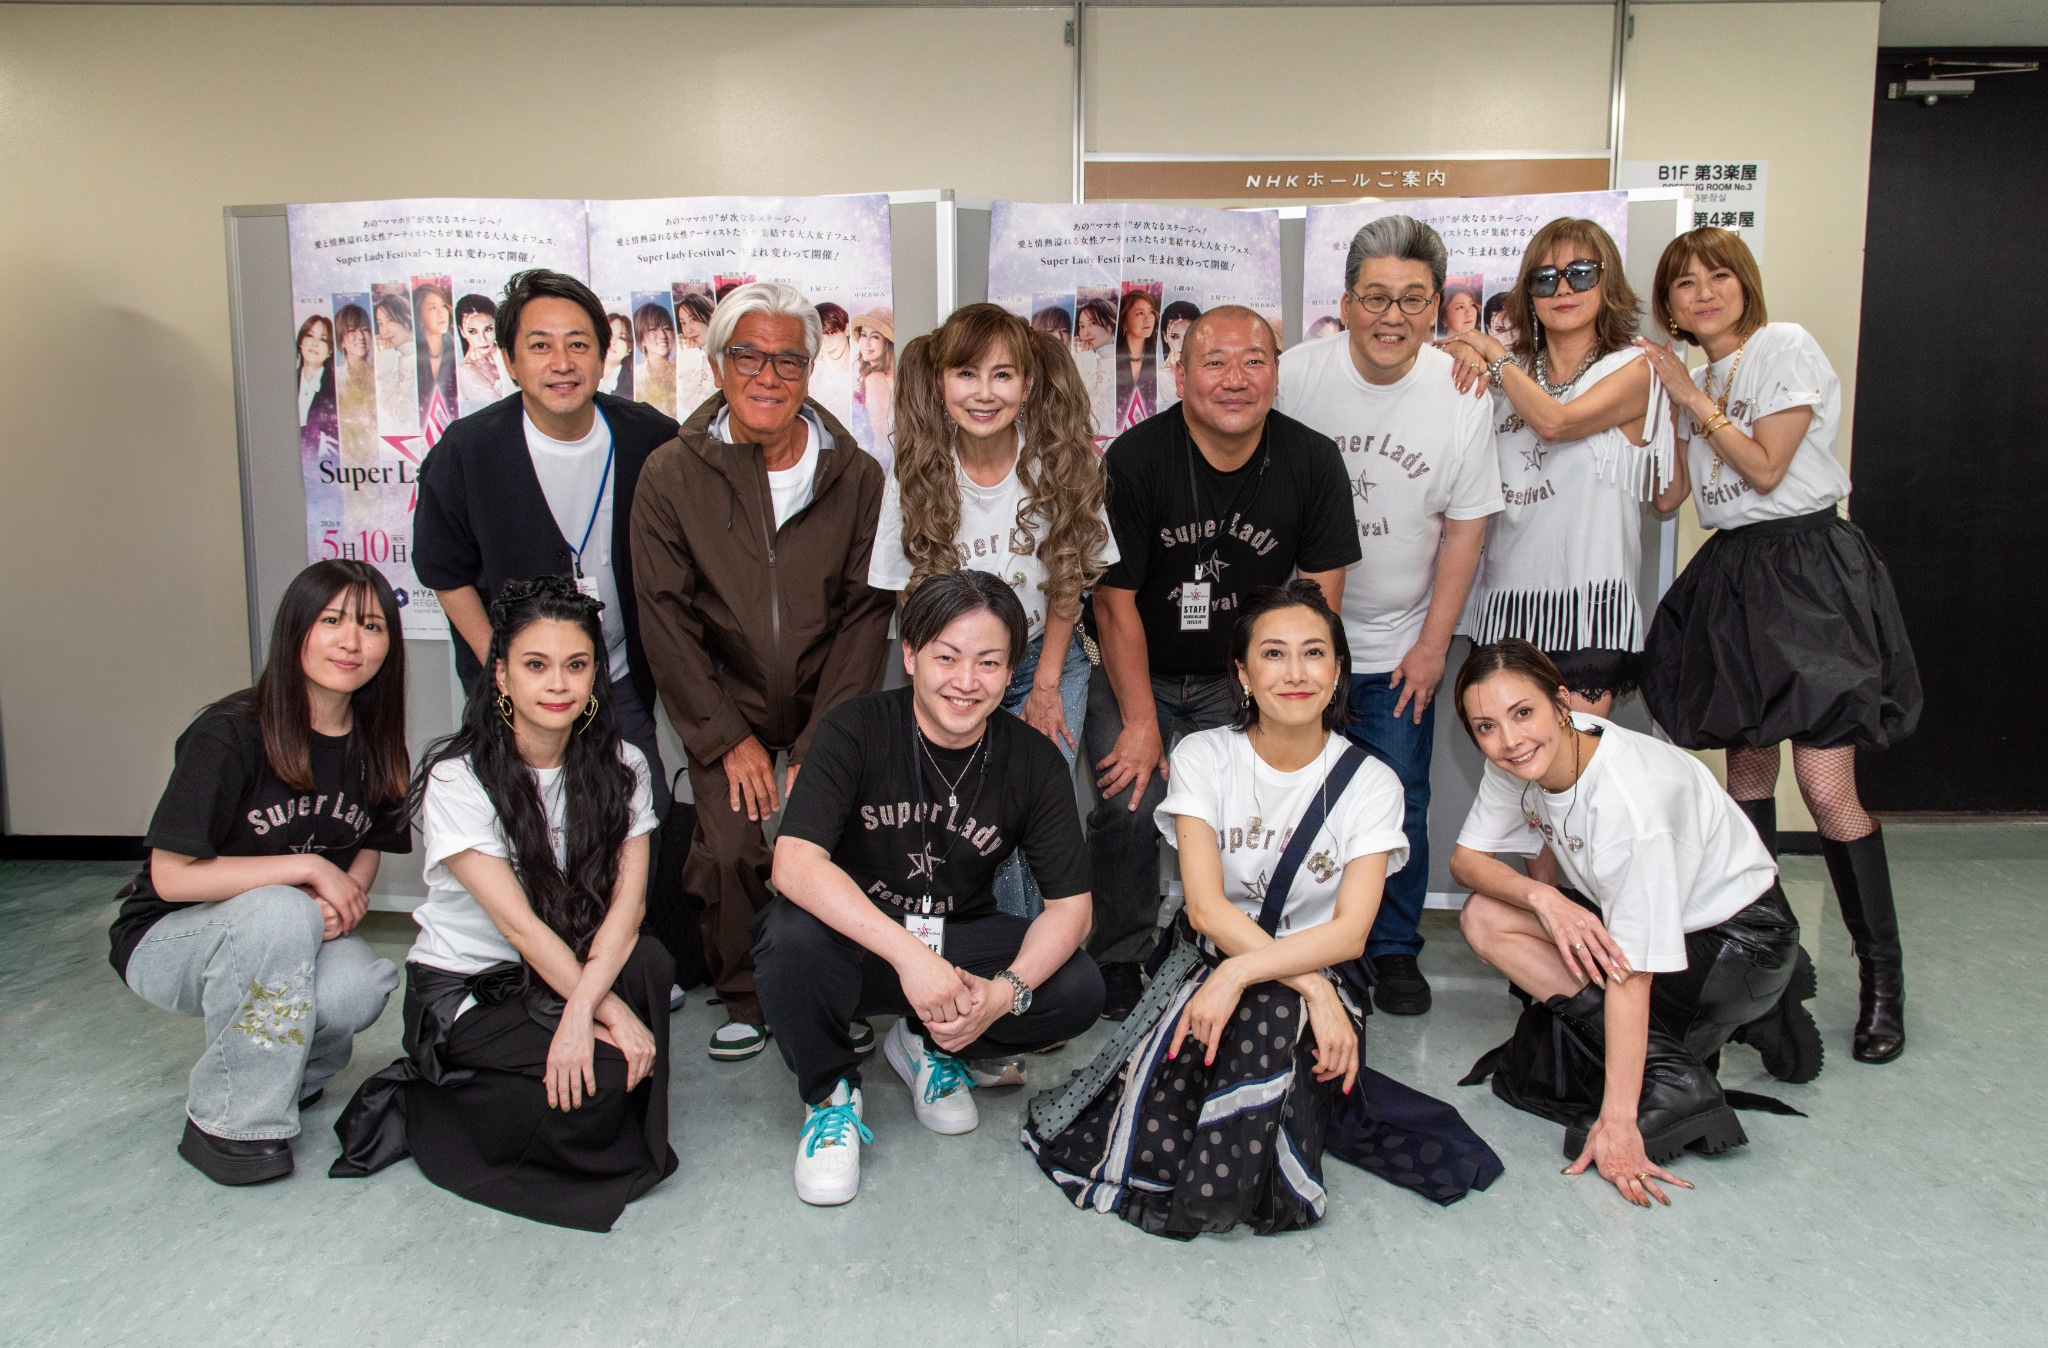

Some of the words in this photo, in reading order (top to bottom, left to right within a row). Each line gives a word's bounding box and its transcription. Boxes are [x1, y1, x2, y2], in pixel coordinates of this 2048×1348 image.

[1658, 165, 1689, 180] B1F
[1694, 164, 1757, 181] 第3楽屋
[1706, 183, 1732, 191] ROOM
[1734, 183, 1753, 191] No.3
[1693, 211, 1755, 228] 第4楽屋
[336, 254, 362, 266] Super
[364, 252, 385, 264] Lady
[637, 253, 663, 265] Super
[666, 251, 686, 263] Lady
[1040, 256, 1070, 268] Super
[1072, 255, 1095, 267] Lady
[1378, 433, 1431, 480] Lady
[319, 460, 393, 491] Super
[1701, 478, 1752, 506] Festiva
[1228, 512, 1279, 556] Lady
[955, 534, 999, 567] per
[413, 599, 439, 607] REGE
[1183, 605, 1207, 614] STAFF
[860, 801, 943, 831] Super
[946, 803, 1003, 857] Lady
